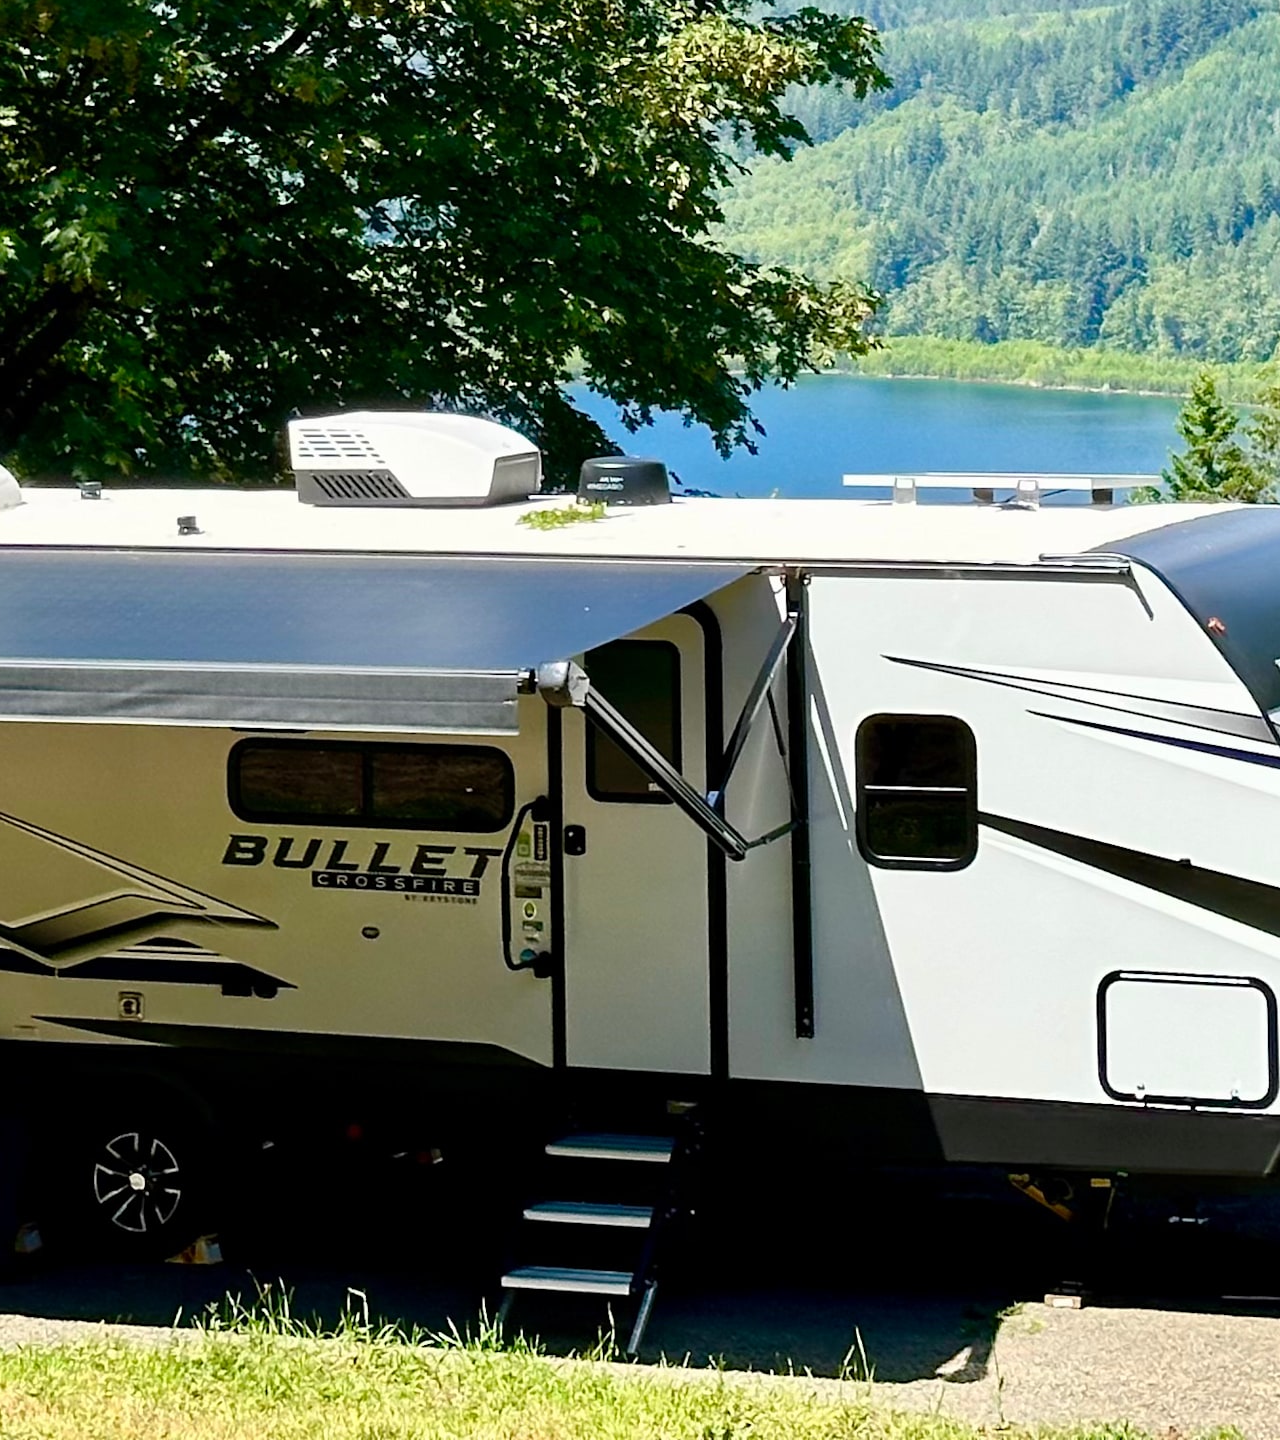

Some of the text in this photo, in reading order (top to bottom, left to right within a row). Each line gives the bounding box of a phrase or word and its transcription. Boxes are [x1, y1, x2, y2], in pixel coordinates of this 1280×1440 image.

[222, 834, 504, 879] BULLET
[317, 873, 474, 893] CROSSFIRE
[423, 895, 478, 905] KEYSTONE
